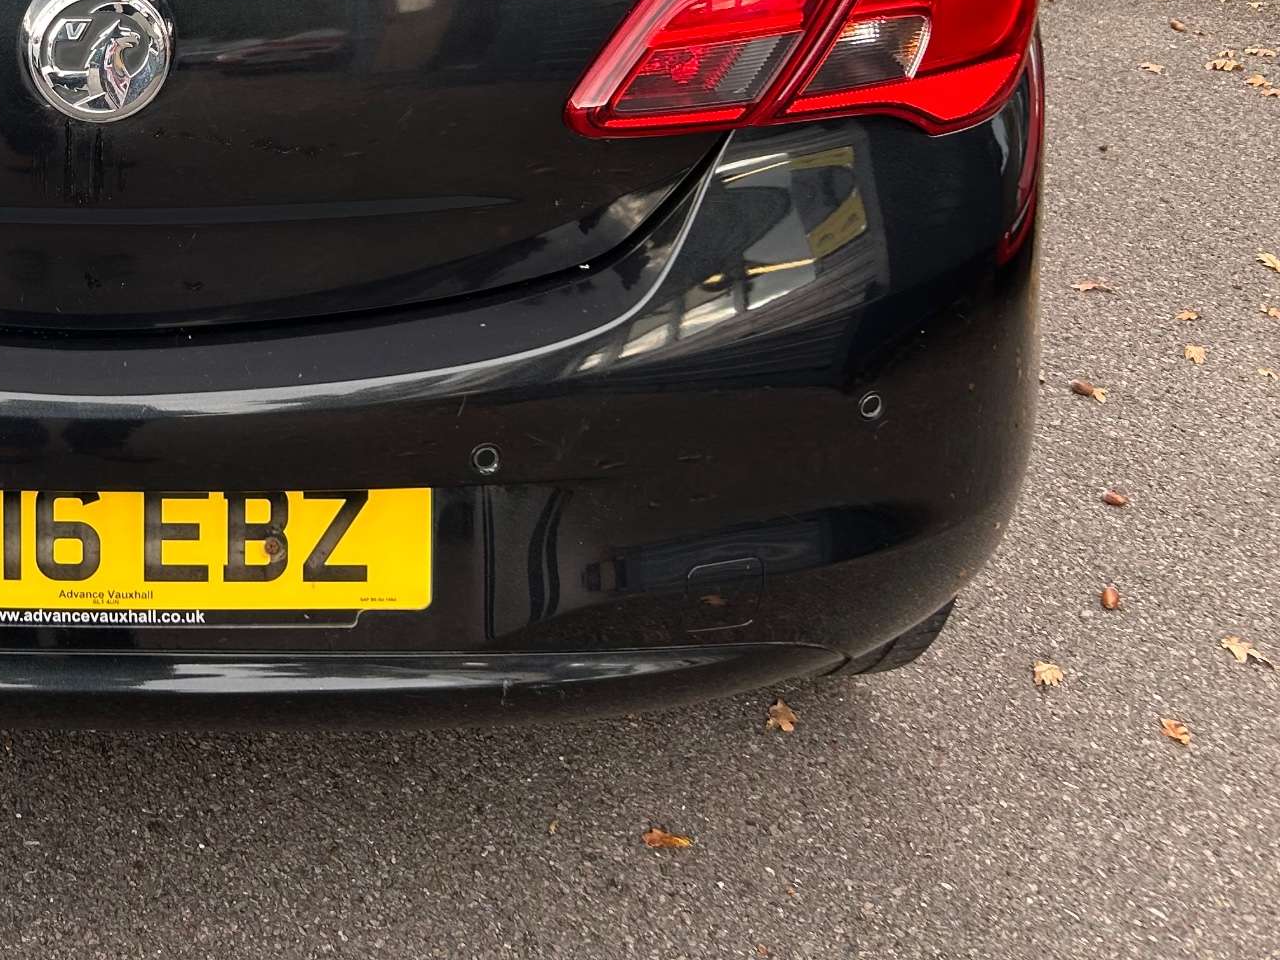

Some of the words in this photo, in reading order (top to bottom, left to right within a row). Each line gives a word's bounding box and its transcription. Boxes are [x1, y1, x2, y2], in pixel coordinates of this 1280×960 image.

[143, 490, 369, 582] EBZ
[58, 589, 104, 599] Advance
[107, 590, 153, 600] Vauxhall
